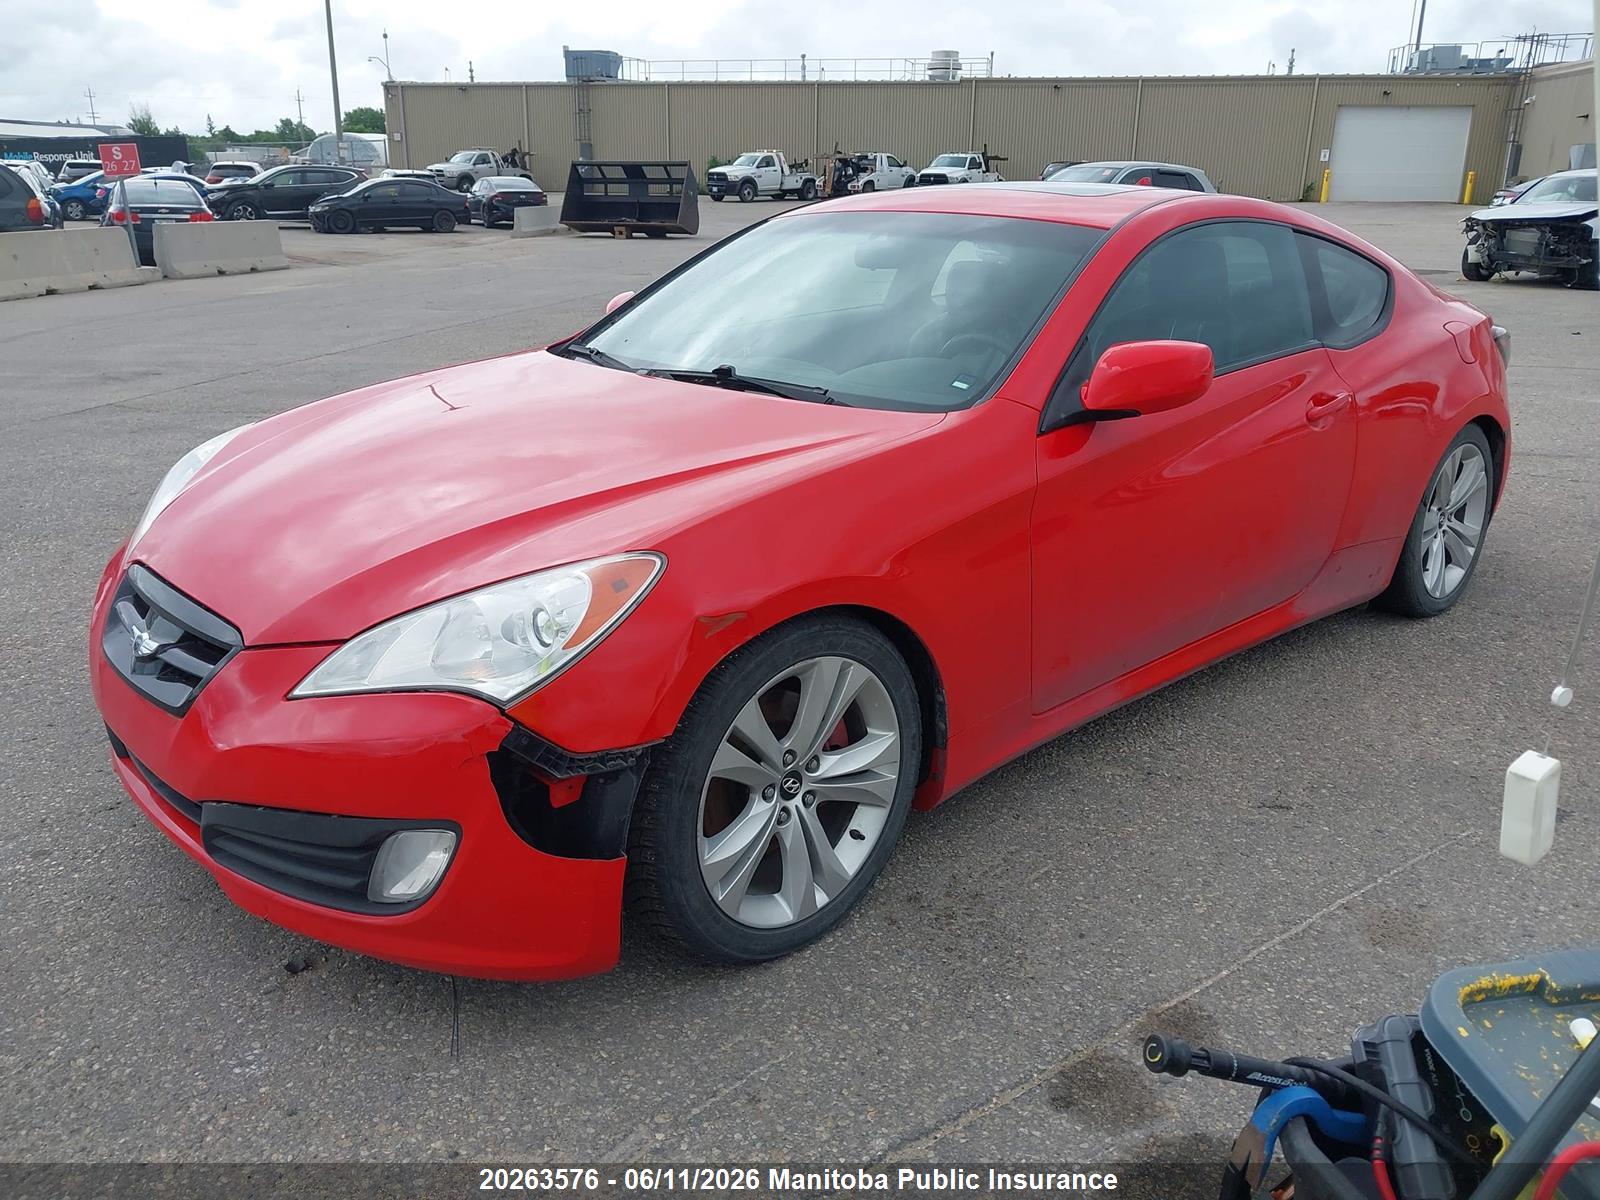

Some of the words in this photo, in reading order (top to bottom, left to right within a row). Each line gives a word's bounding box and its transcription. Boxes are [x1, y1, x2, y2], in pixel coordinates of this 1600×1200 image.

[4, 152, 32, 160] Mobile
[33, 152, 74, 163] Response
[75, 151, 95, 161] Unit
[111, 146, 122, 160] S
[104, 161, 117, 171] 26
[122, 160, 136, 170] 27
